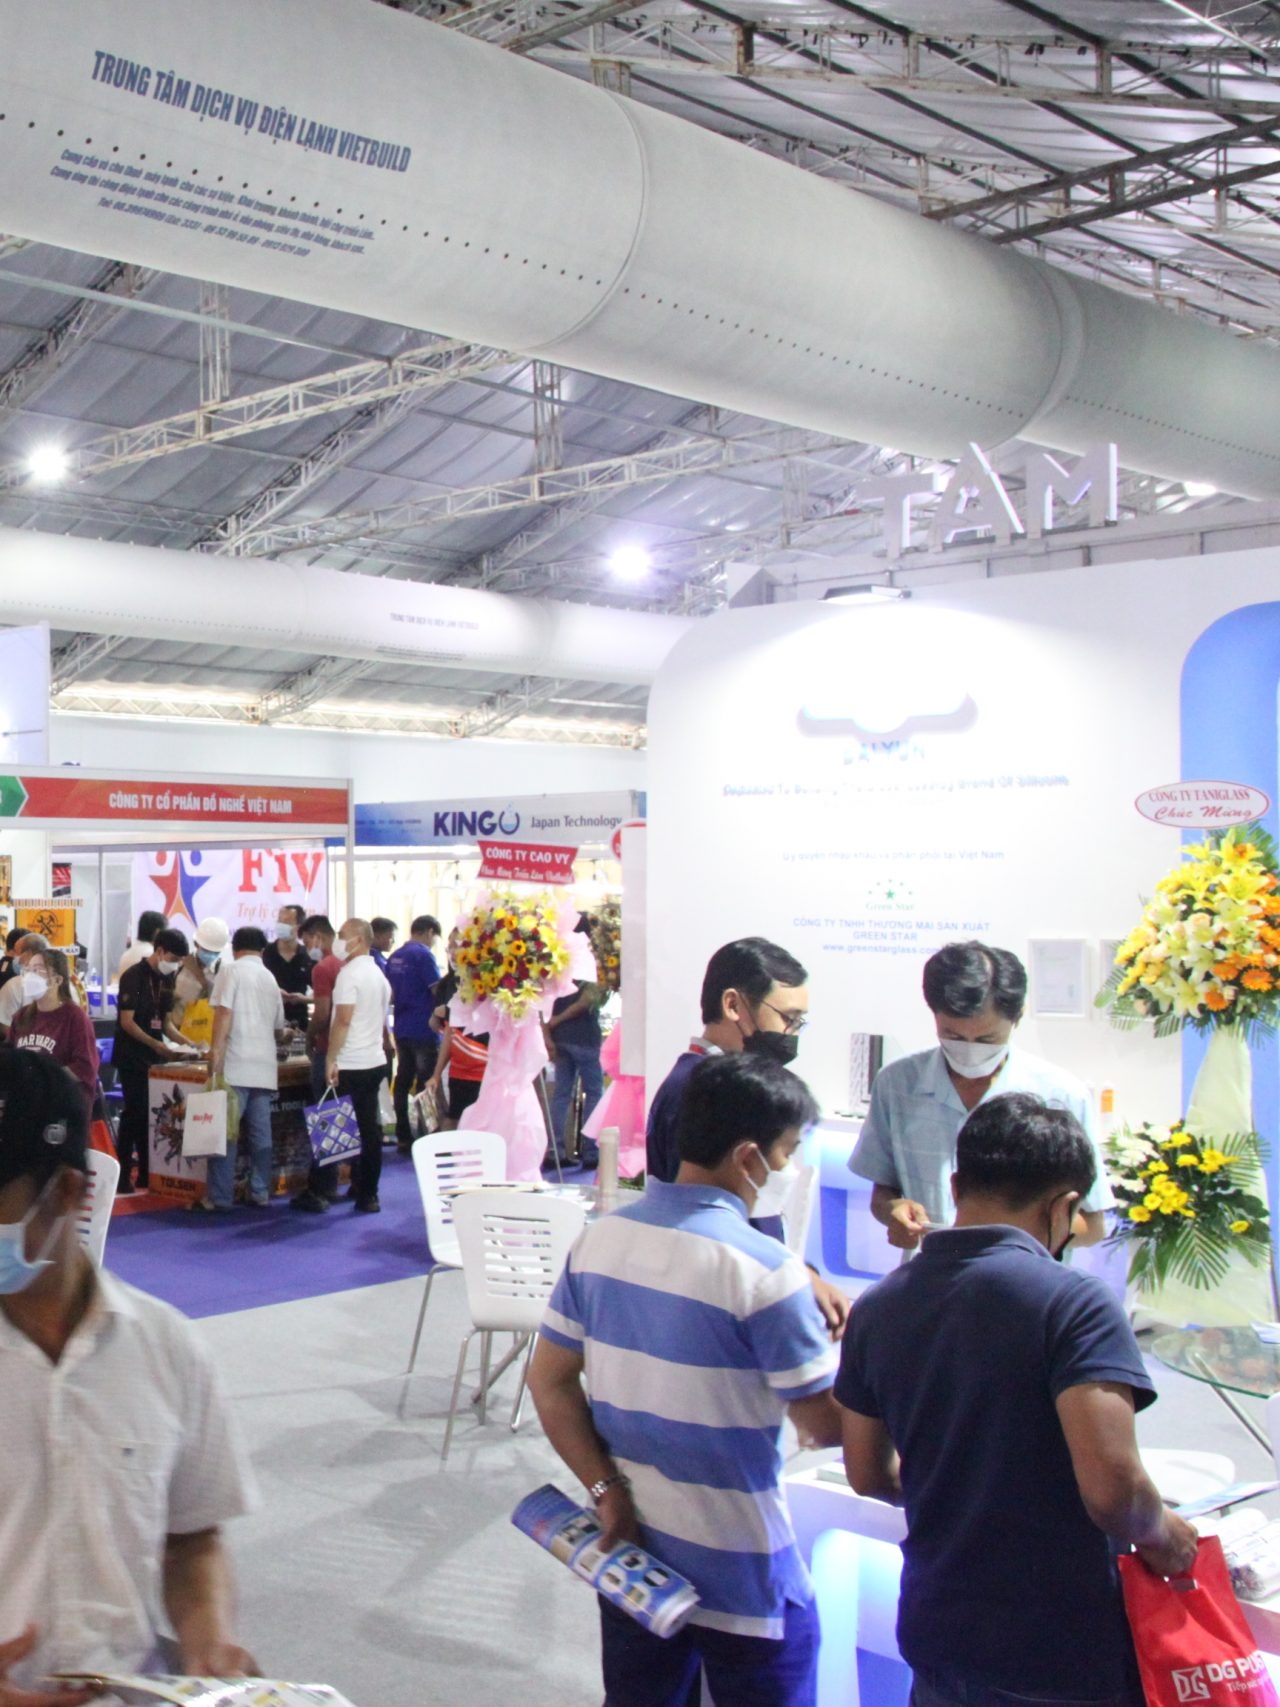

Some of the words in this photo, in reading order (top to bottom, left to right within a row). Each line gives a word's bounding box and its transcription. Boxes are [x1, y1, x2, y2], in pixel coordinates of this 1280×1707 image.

[91, 50, 152, 96] TRUNG
[153, 70, 191, 109] TÂM
[190, 84, 234, 122] DỊCH
[234, 97, 259, 135] VỤ
[258, 106, 297, 145] ĐIỆN
[296, 118, 338, 155] LẠNH
[337, 130, 412, 172] VIETBUILD
[109, 791, 138, 808] CÔNG
[142, 795, 154, 809] TY
[248, 796, 268, 816] VIỆT
[270, 799, 292, 813] NAM
[1149, 790, 1178, 802] CÔNG
[1180, 790, 1192, 801] TY
[531, 816, 560, 830] Japan
[564, 815, 622, 829] Technology
[486, 846, 512, 859] CÔNG
[515, 849, 527, 860] TY
[530, 850, 552, 863] CAO
[554, 853, 570, 864] VY
[793, 917, 821, 927] CÔNG
[824, 919, 837, 927] TY
[839, 919, 864, 928] TNHH
[852, 931, 888, 940] GREEN
[890, 932, 918, 940] STAR
[16, 1033, 56, 1051] HARVARD
[1206, 1660, 1237, 1682] DG
